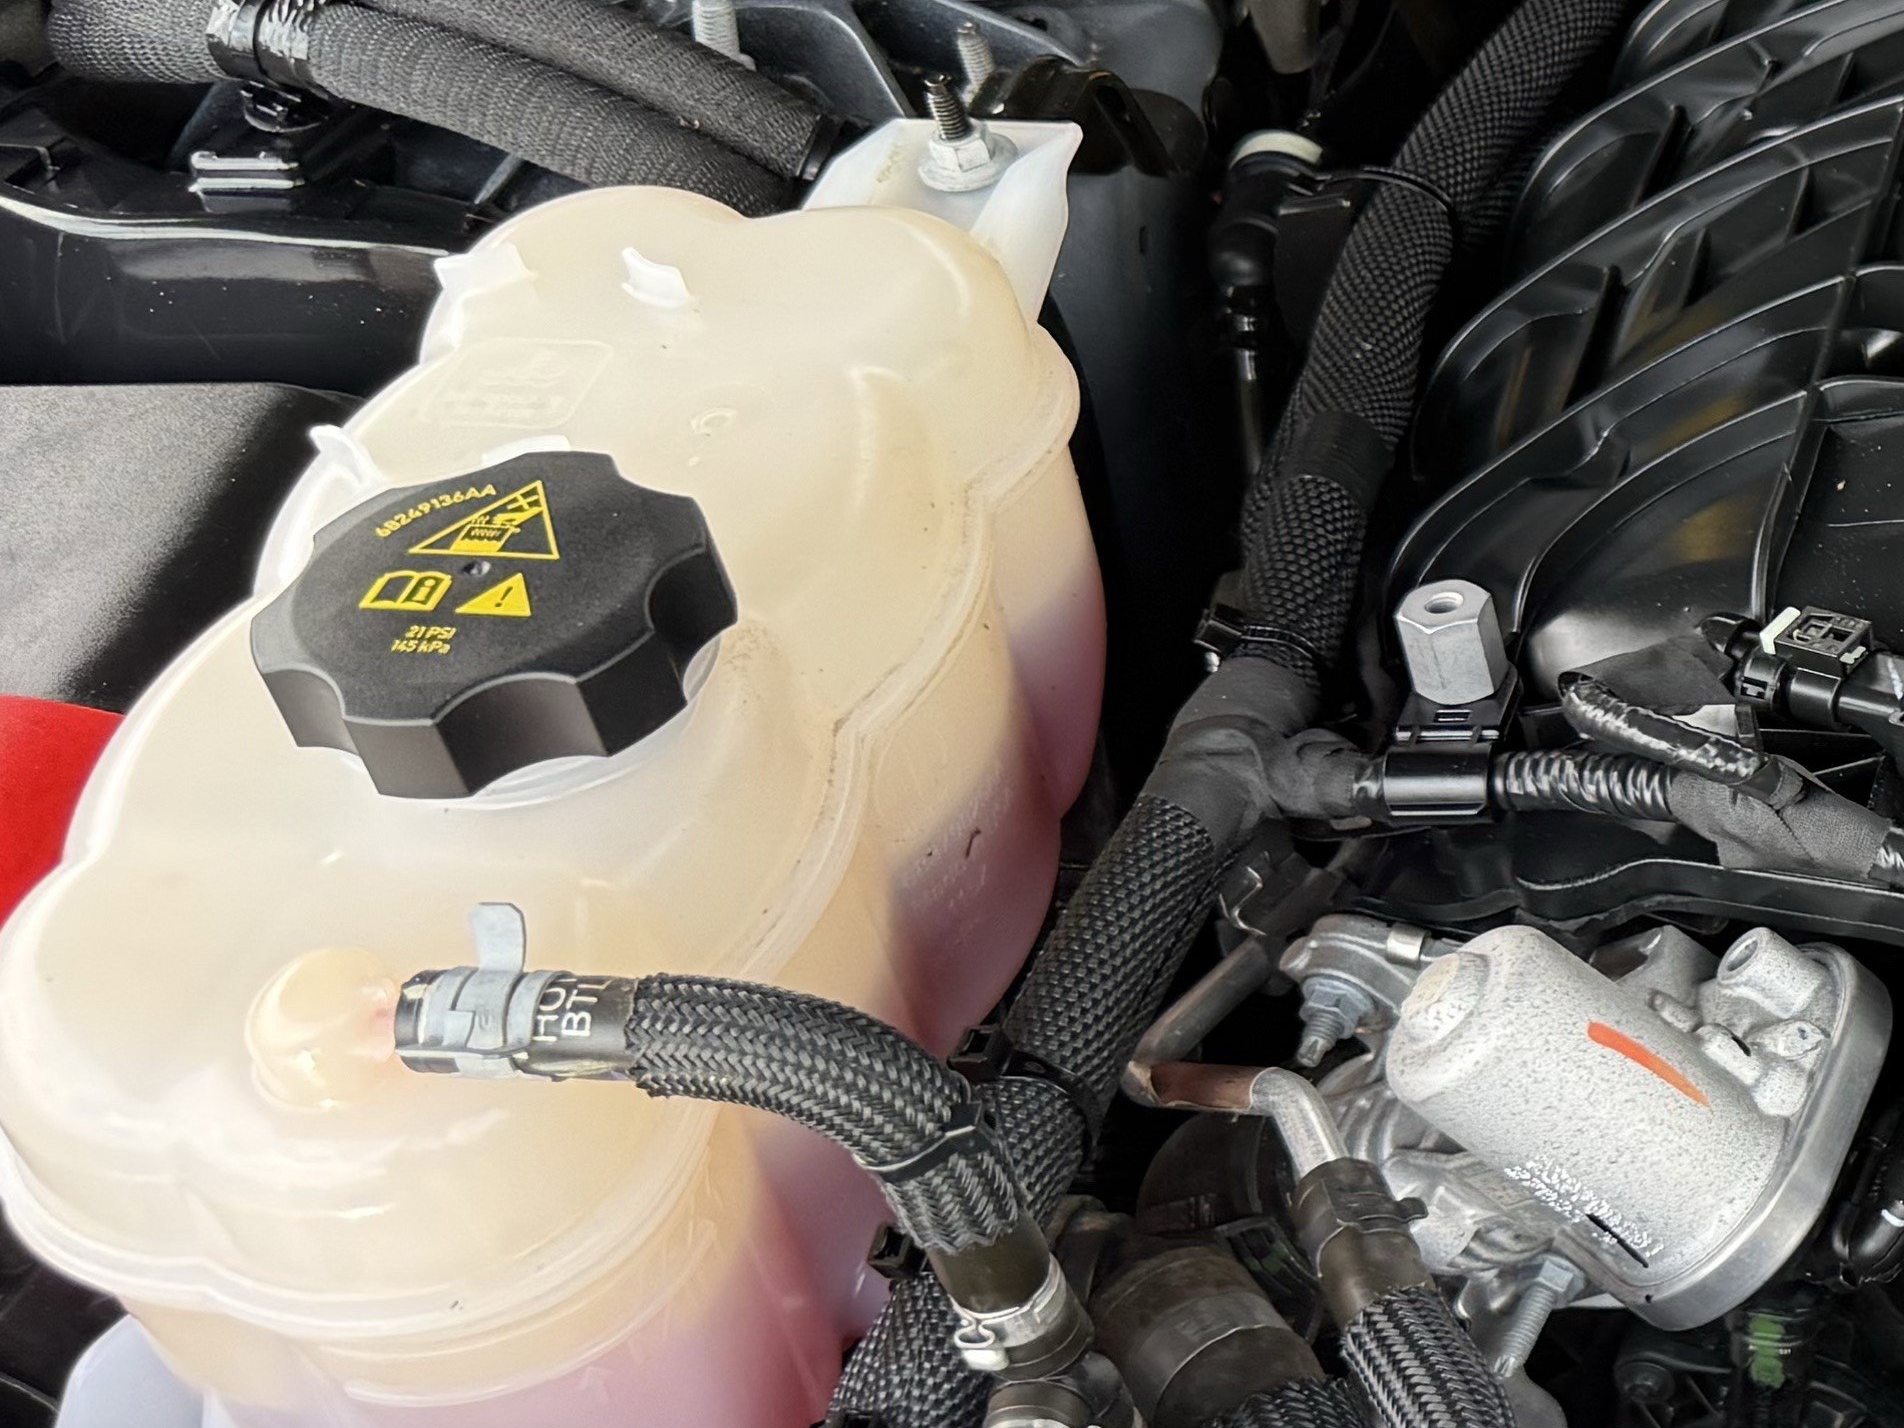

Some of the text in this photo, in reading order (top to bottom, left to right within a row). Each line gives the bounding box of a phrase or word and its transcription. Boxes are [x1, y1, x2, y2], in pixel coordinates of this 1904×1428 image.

[405, 625, 457, 640] 21 PSI
[391, 639, 418, 653] 145
[561, 978, 614, 1037] BTL
